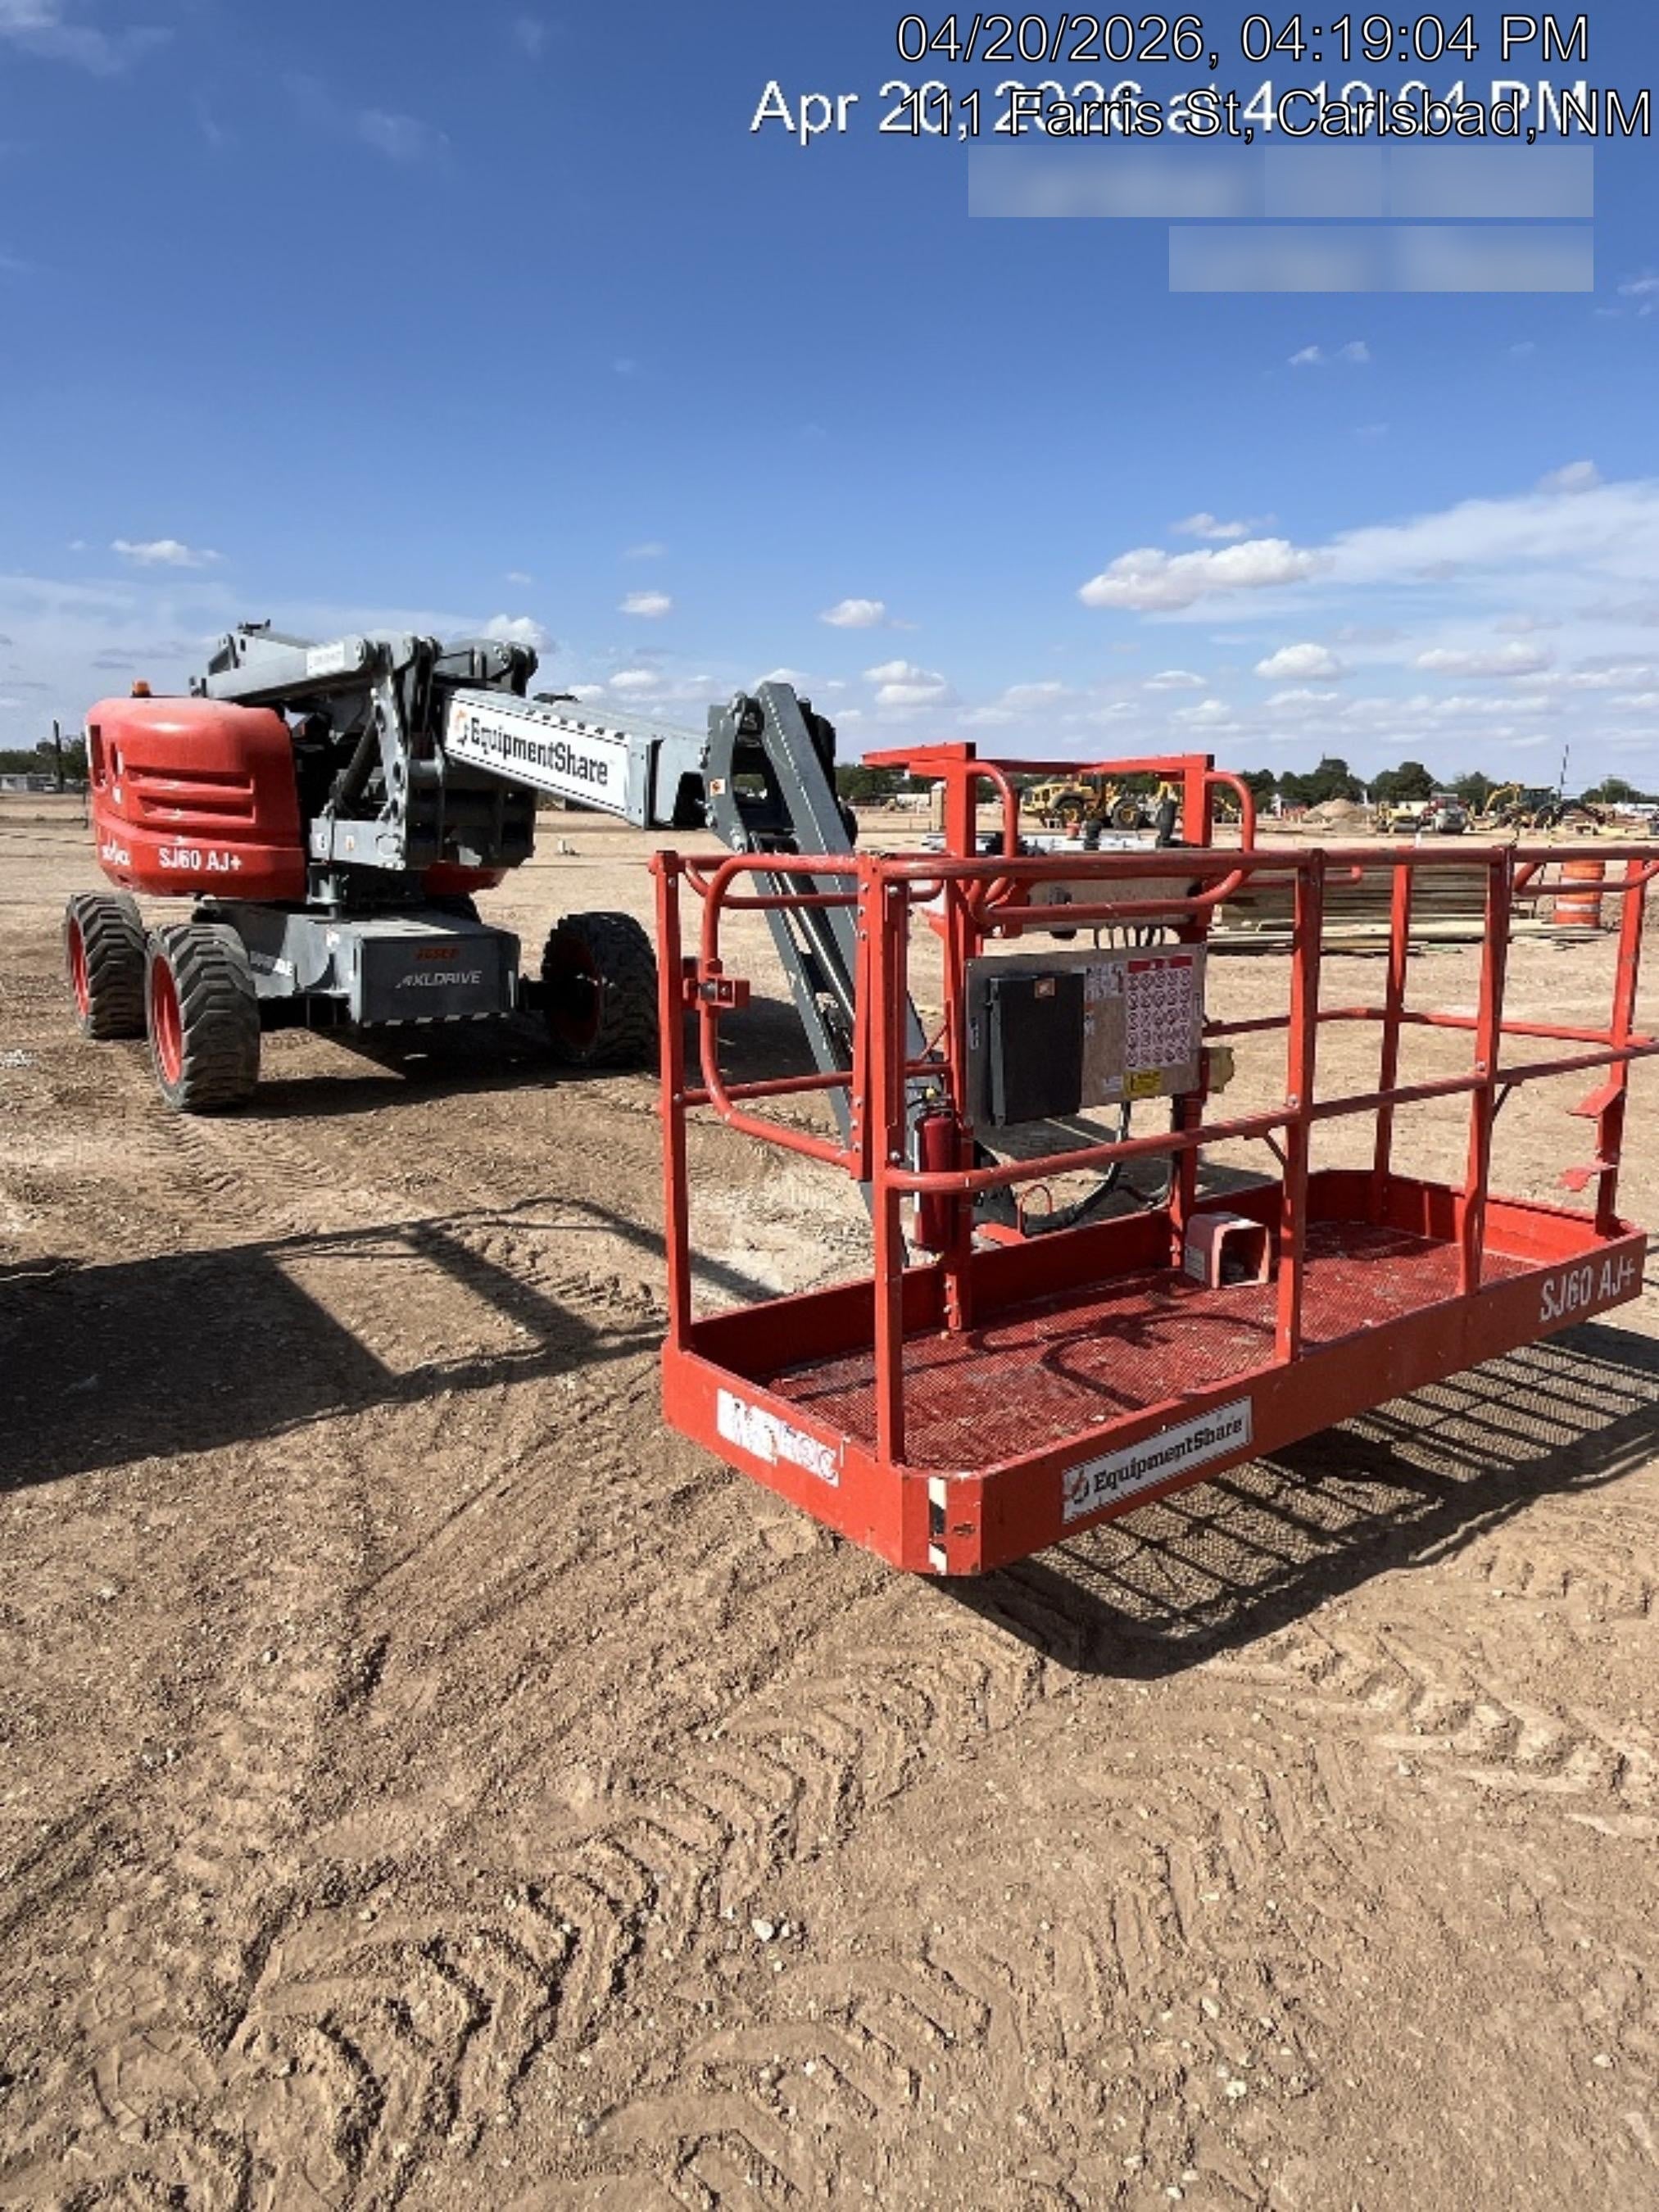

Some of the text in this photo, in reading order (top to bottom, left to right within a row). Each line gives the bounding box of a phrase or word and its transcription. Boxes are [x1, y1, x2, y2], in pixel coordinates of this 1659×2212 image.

[470, 716, 609, 786] EquipmentShare
[158, 846, 202, 871] SJ60
[206, 850, 243, 872] AJ+
[1539, 1255, 1636, 1322] SJ60 AJ+
[1093, 1416, 1243, 1494] EquipmentShare
